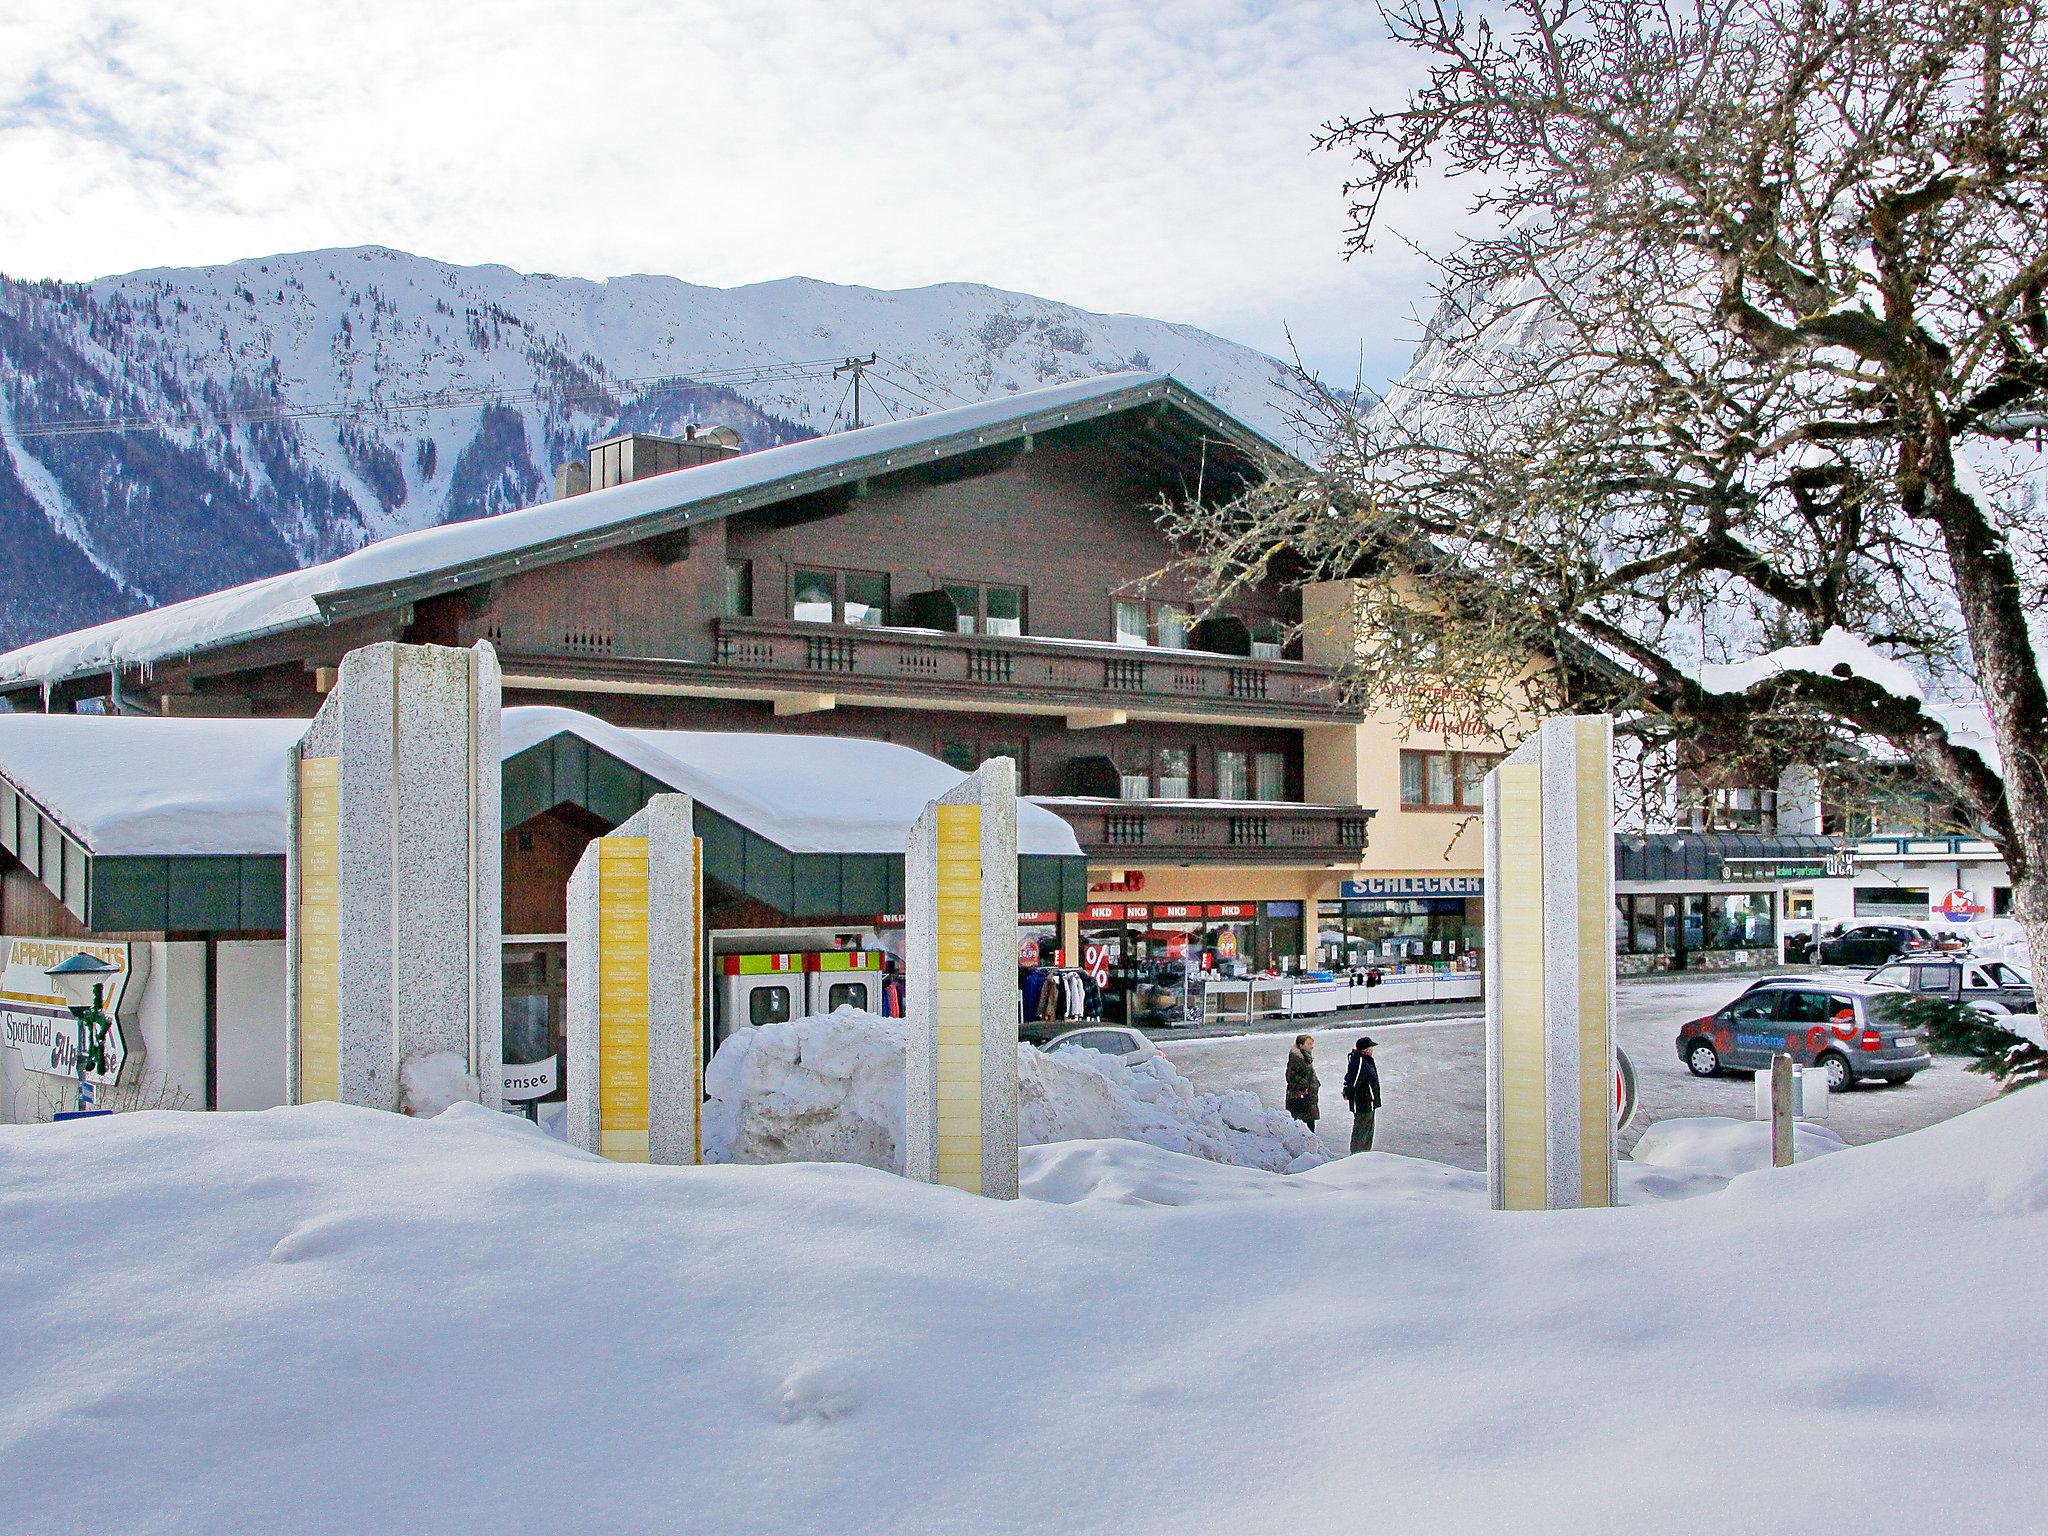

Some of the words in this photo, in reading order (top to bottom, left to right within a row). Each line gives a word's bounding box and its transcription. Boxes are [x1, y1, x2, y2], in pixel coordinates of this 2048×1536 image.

[1353, 878, 1480, 893] SCHLECKER
[1092, 908, 1112, 917] NKD
[1127, 908, 1147, 917] NKD
[1168, 907, 1187, 916] NKD
[1222, 906, 1241, 915] NKD
[883, 914, 905, 922] NKD
[11, 942, 125, 973] APPARTENTS
[6, 1013, 52, 1047] Sporthotel
[504, 1075, 548, 1088] ensee
